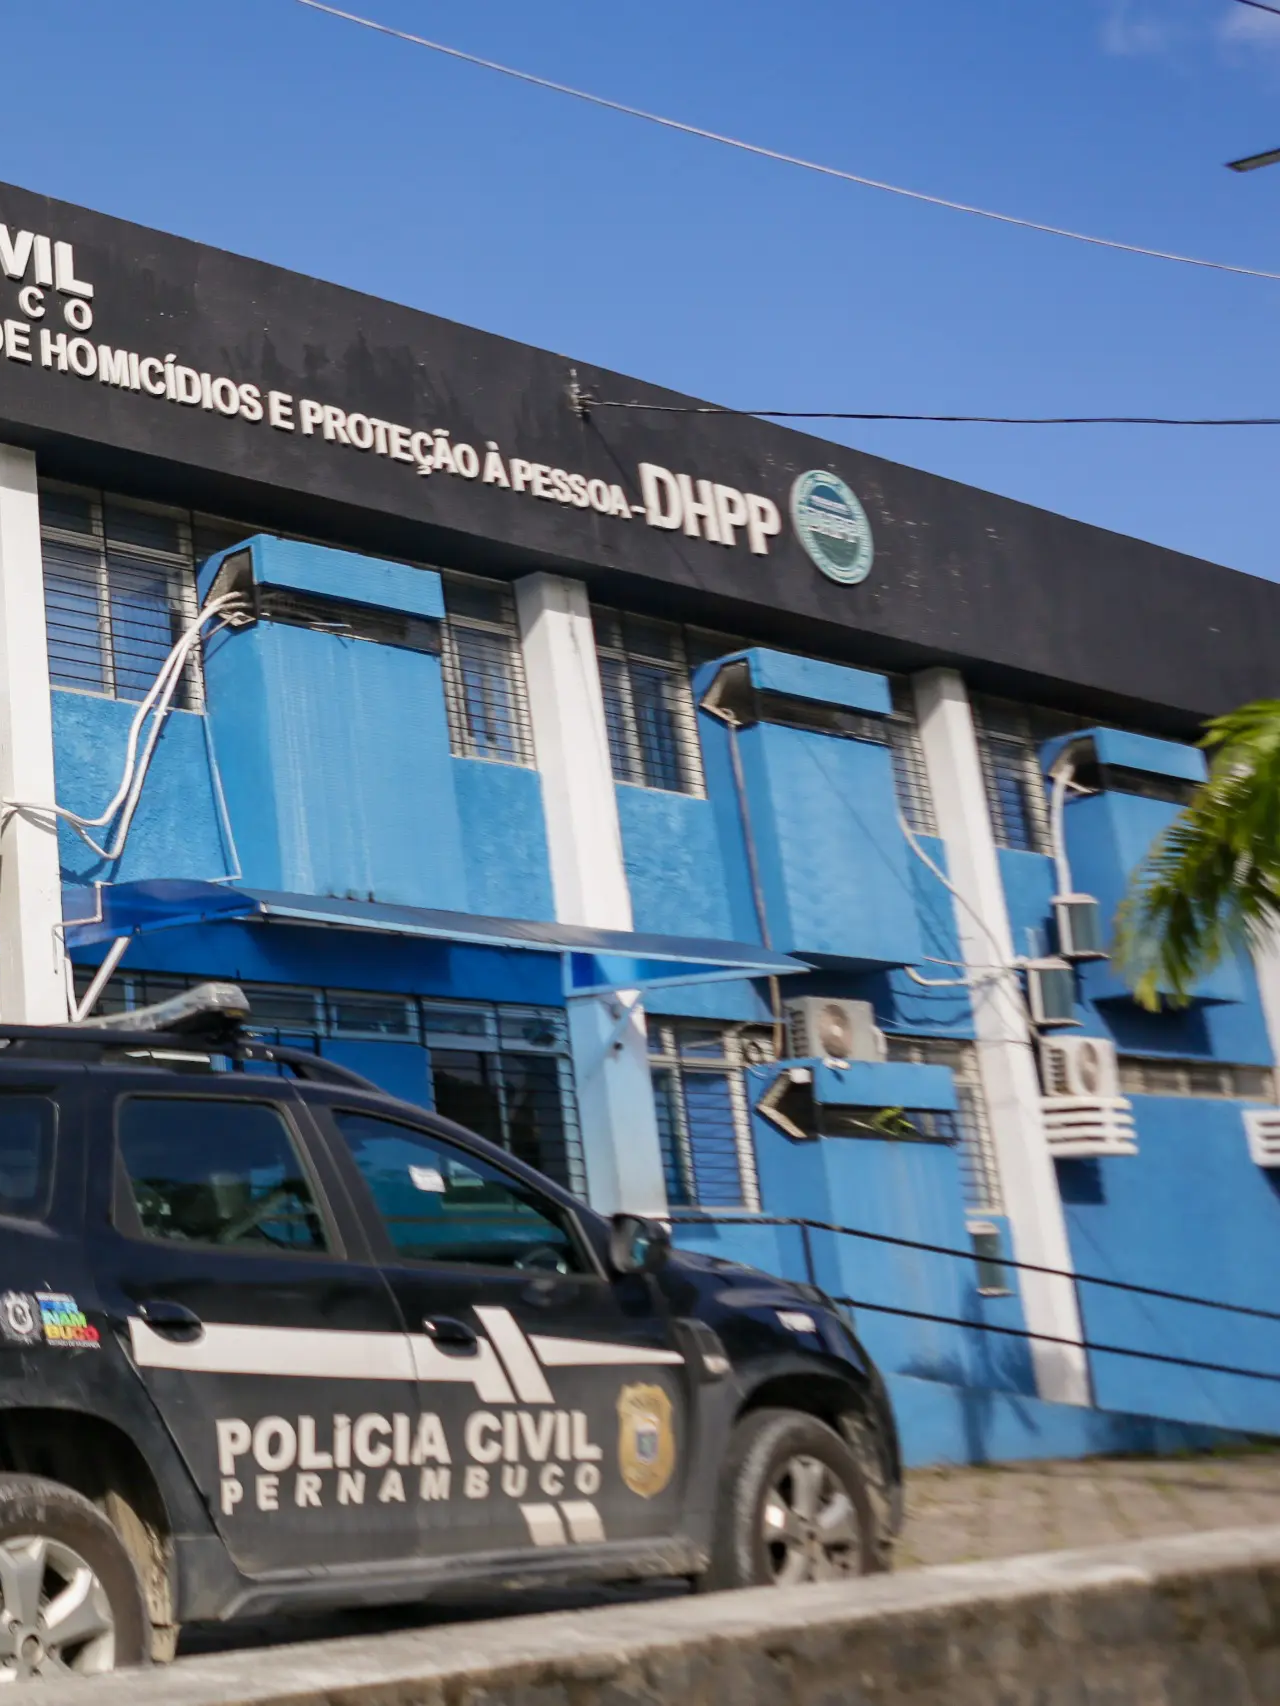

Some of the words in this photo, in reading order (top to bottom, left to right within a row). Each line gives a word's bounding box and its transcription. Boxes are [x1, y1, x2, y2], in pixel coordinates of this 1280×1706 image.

[40, 328, 264, 424] HOMICÍDIOS
[269, 390, 295, 431] E
[299, 398, 480, 476] PROTEÇÃO
[482, 440, 511, 489] À
[44, 1324, 101, 1342] BUCO
[465, 1409, 603, 1466] CIVIL
[221, 1462, 602, 1516] PERNAMBUCO
